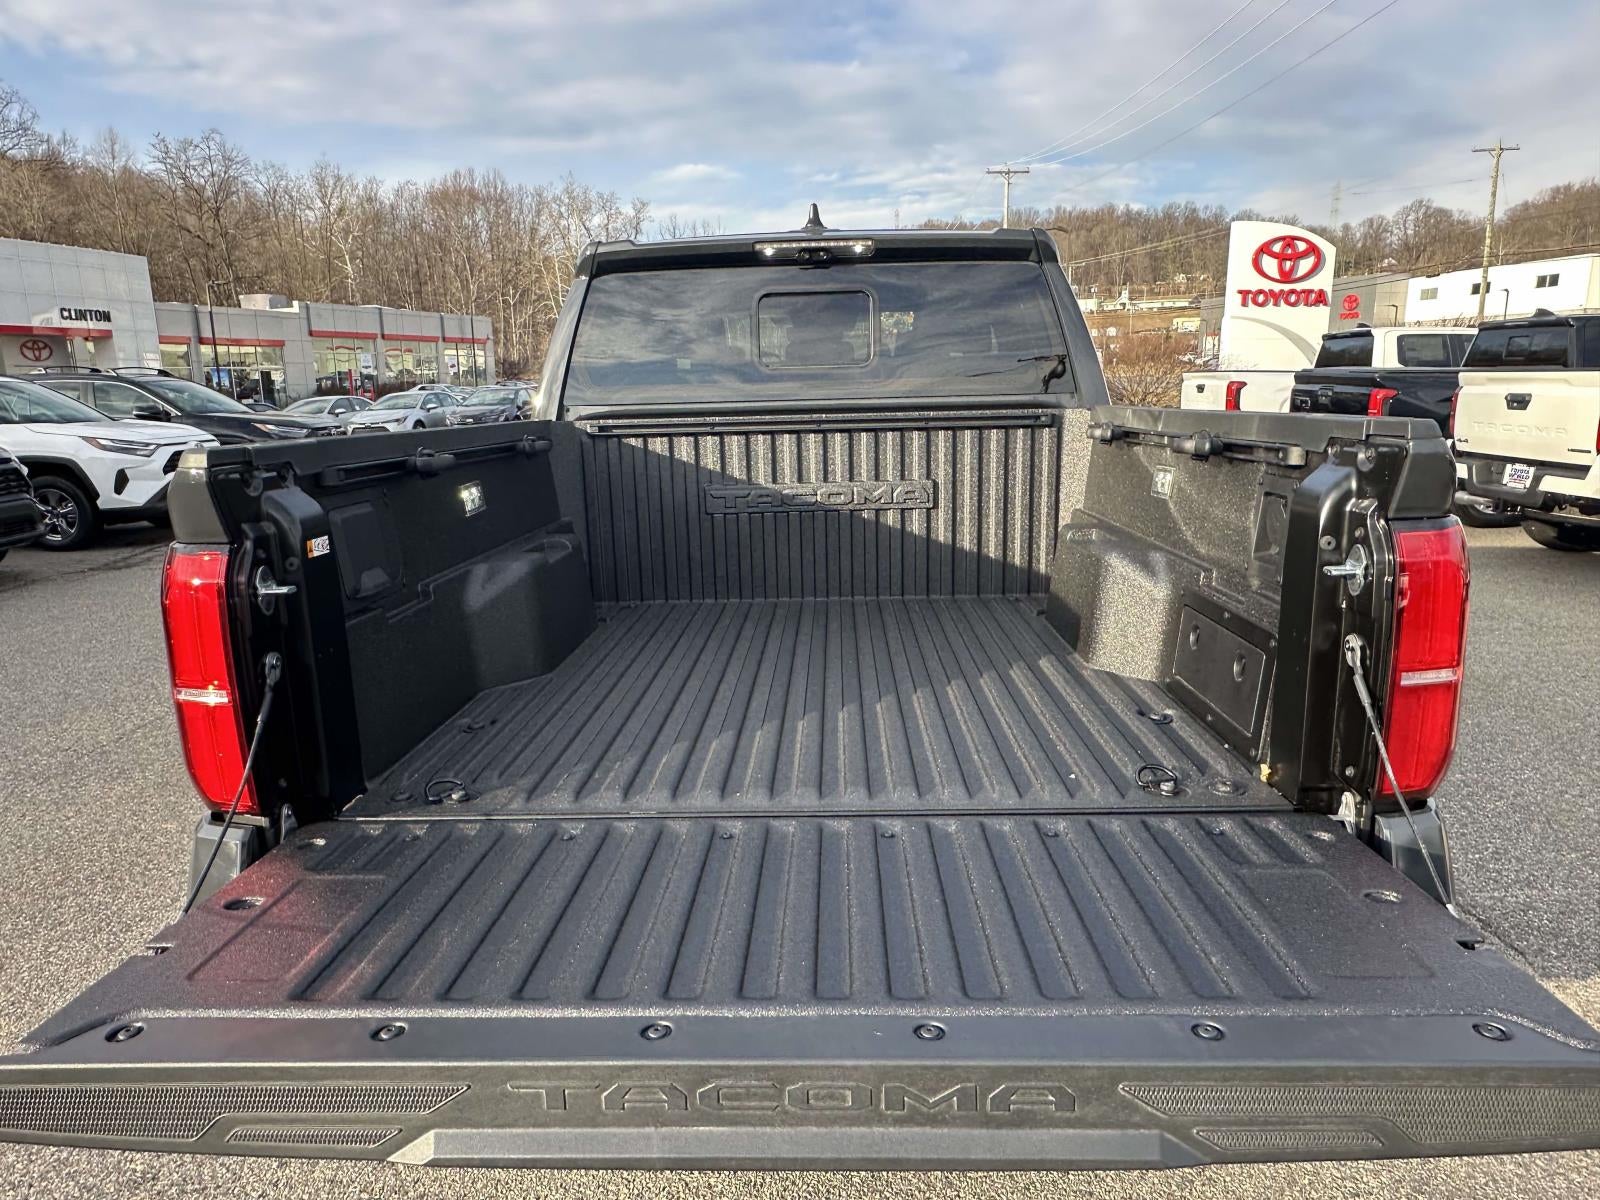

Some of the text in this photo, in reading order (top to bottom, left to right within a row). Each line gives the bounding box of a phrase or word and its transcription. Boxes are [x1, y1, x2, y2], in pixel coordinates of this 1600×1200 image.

[1237, 288, 1330, 308] TOYOTA
[60, 307, 112, 323] CLINTON
[1472, 420, 1570, 438] TACOMA
[1508, 472, 1530, 480] WRLD
[1510, 467, 1530, 475] TOYOTA
[708, 483, 931, 509] TACOMA
[506, 1080, 1077, 1112] TACOMA
